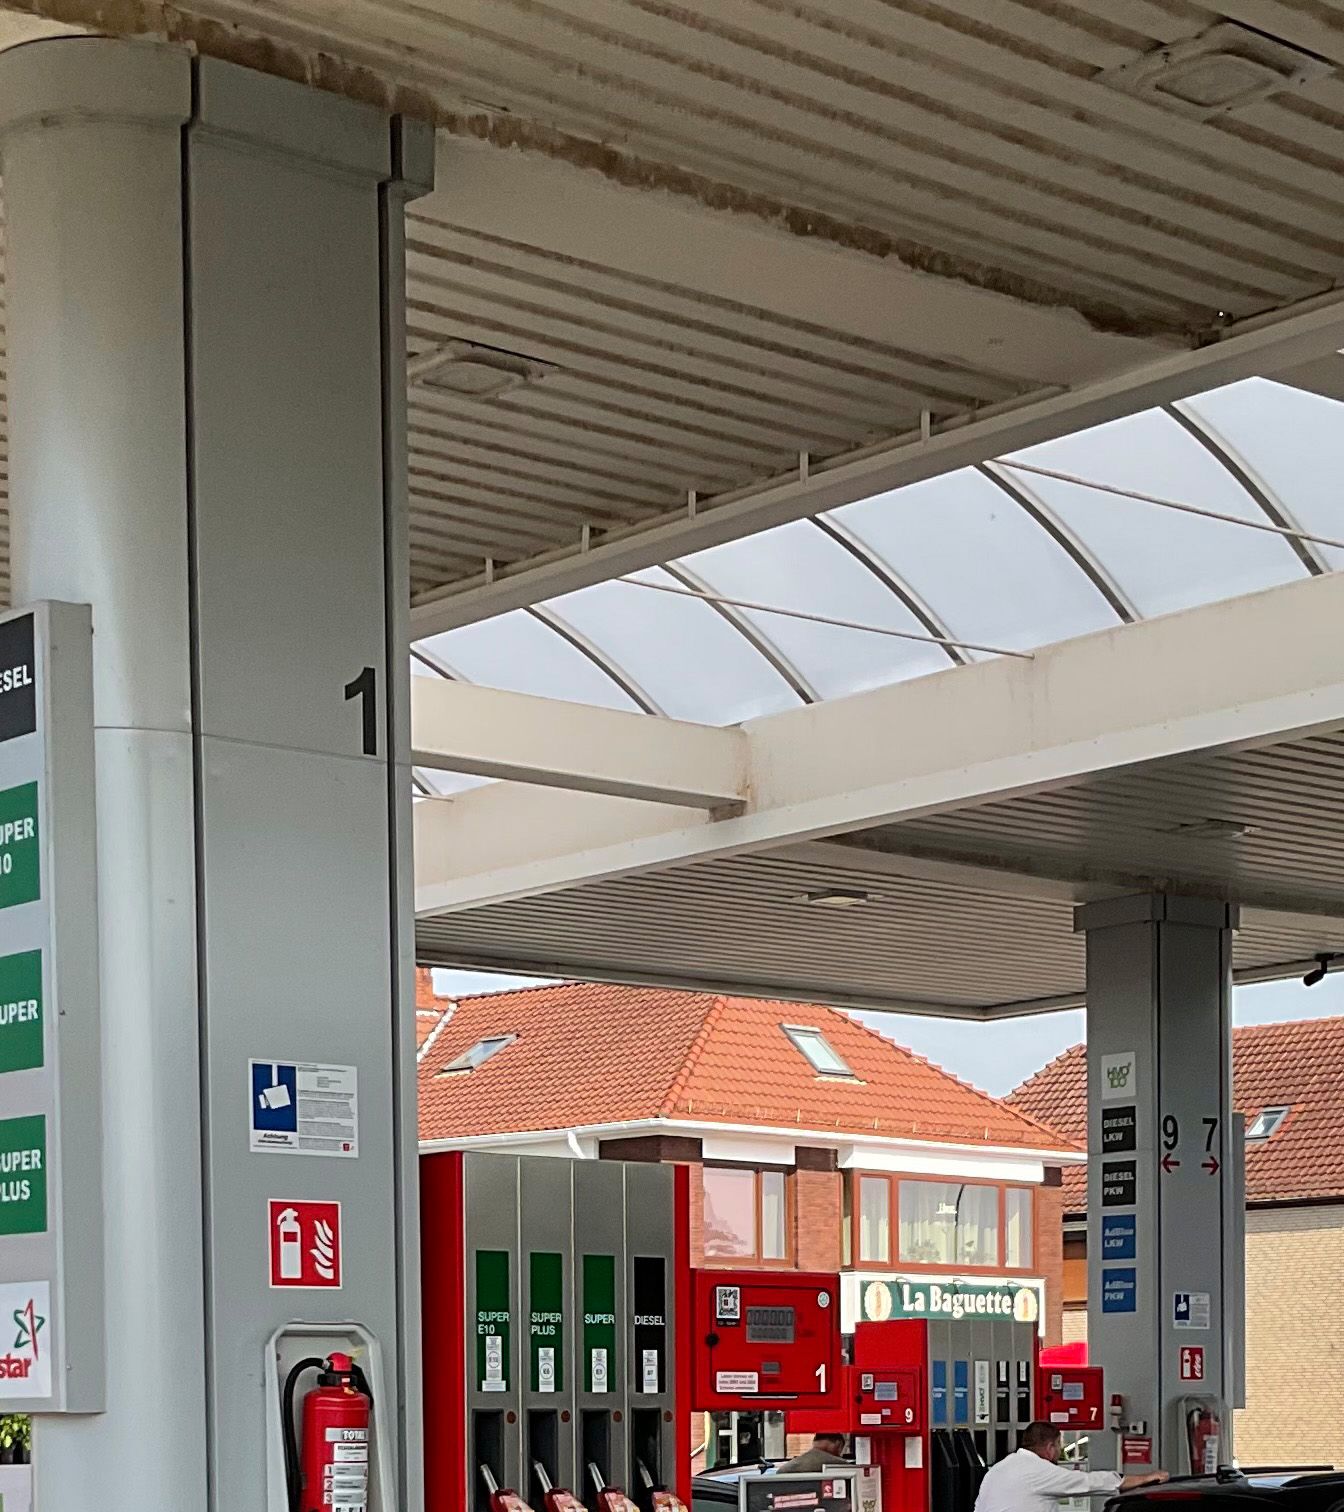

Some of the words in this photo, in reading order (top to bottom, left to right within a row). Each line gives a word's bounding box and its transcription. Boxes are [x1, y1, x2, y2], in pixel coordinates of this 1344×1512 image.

[345, 667, 377, 756] 1
[1103, 1117, 1134, 1128] DIESEL
[1103, 1132, 1123, 1142] LKW
[1163, 1115, 1178, 1150] 9
[1203, 1118, 1217, 1152] 7
[1103, 1172, 1134, 1182] DIESEL
[1103, 1186, 1123, 1195] PKW
[1104, 1239, 1123, 1247] LKW
[902, 1284, 925, 1312] La
[929, 1285, 1015, 1318] Baguette
[1104, 1292, 1124, 1300] PKW
[478, 1312, 509, 1323] SUPER
[531, 1312, 562, 1323] SUPER
[584, 1313, 615, 1324] SUPER
[634, 1315, 665, 1326] DIESEL
[478, 1324, 495, 1335] E10
[531, 1325, 556, 1335] PLUS
[815, 1363, 826, 1392] 1
[905, 1408, 913, 1423] 9
[1089, 1407, 1098, 1421] 7
[343, 1431, 365, 1440] TOTAL
